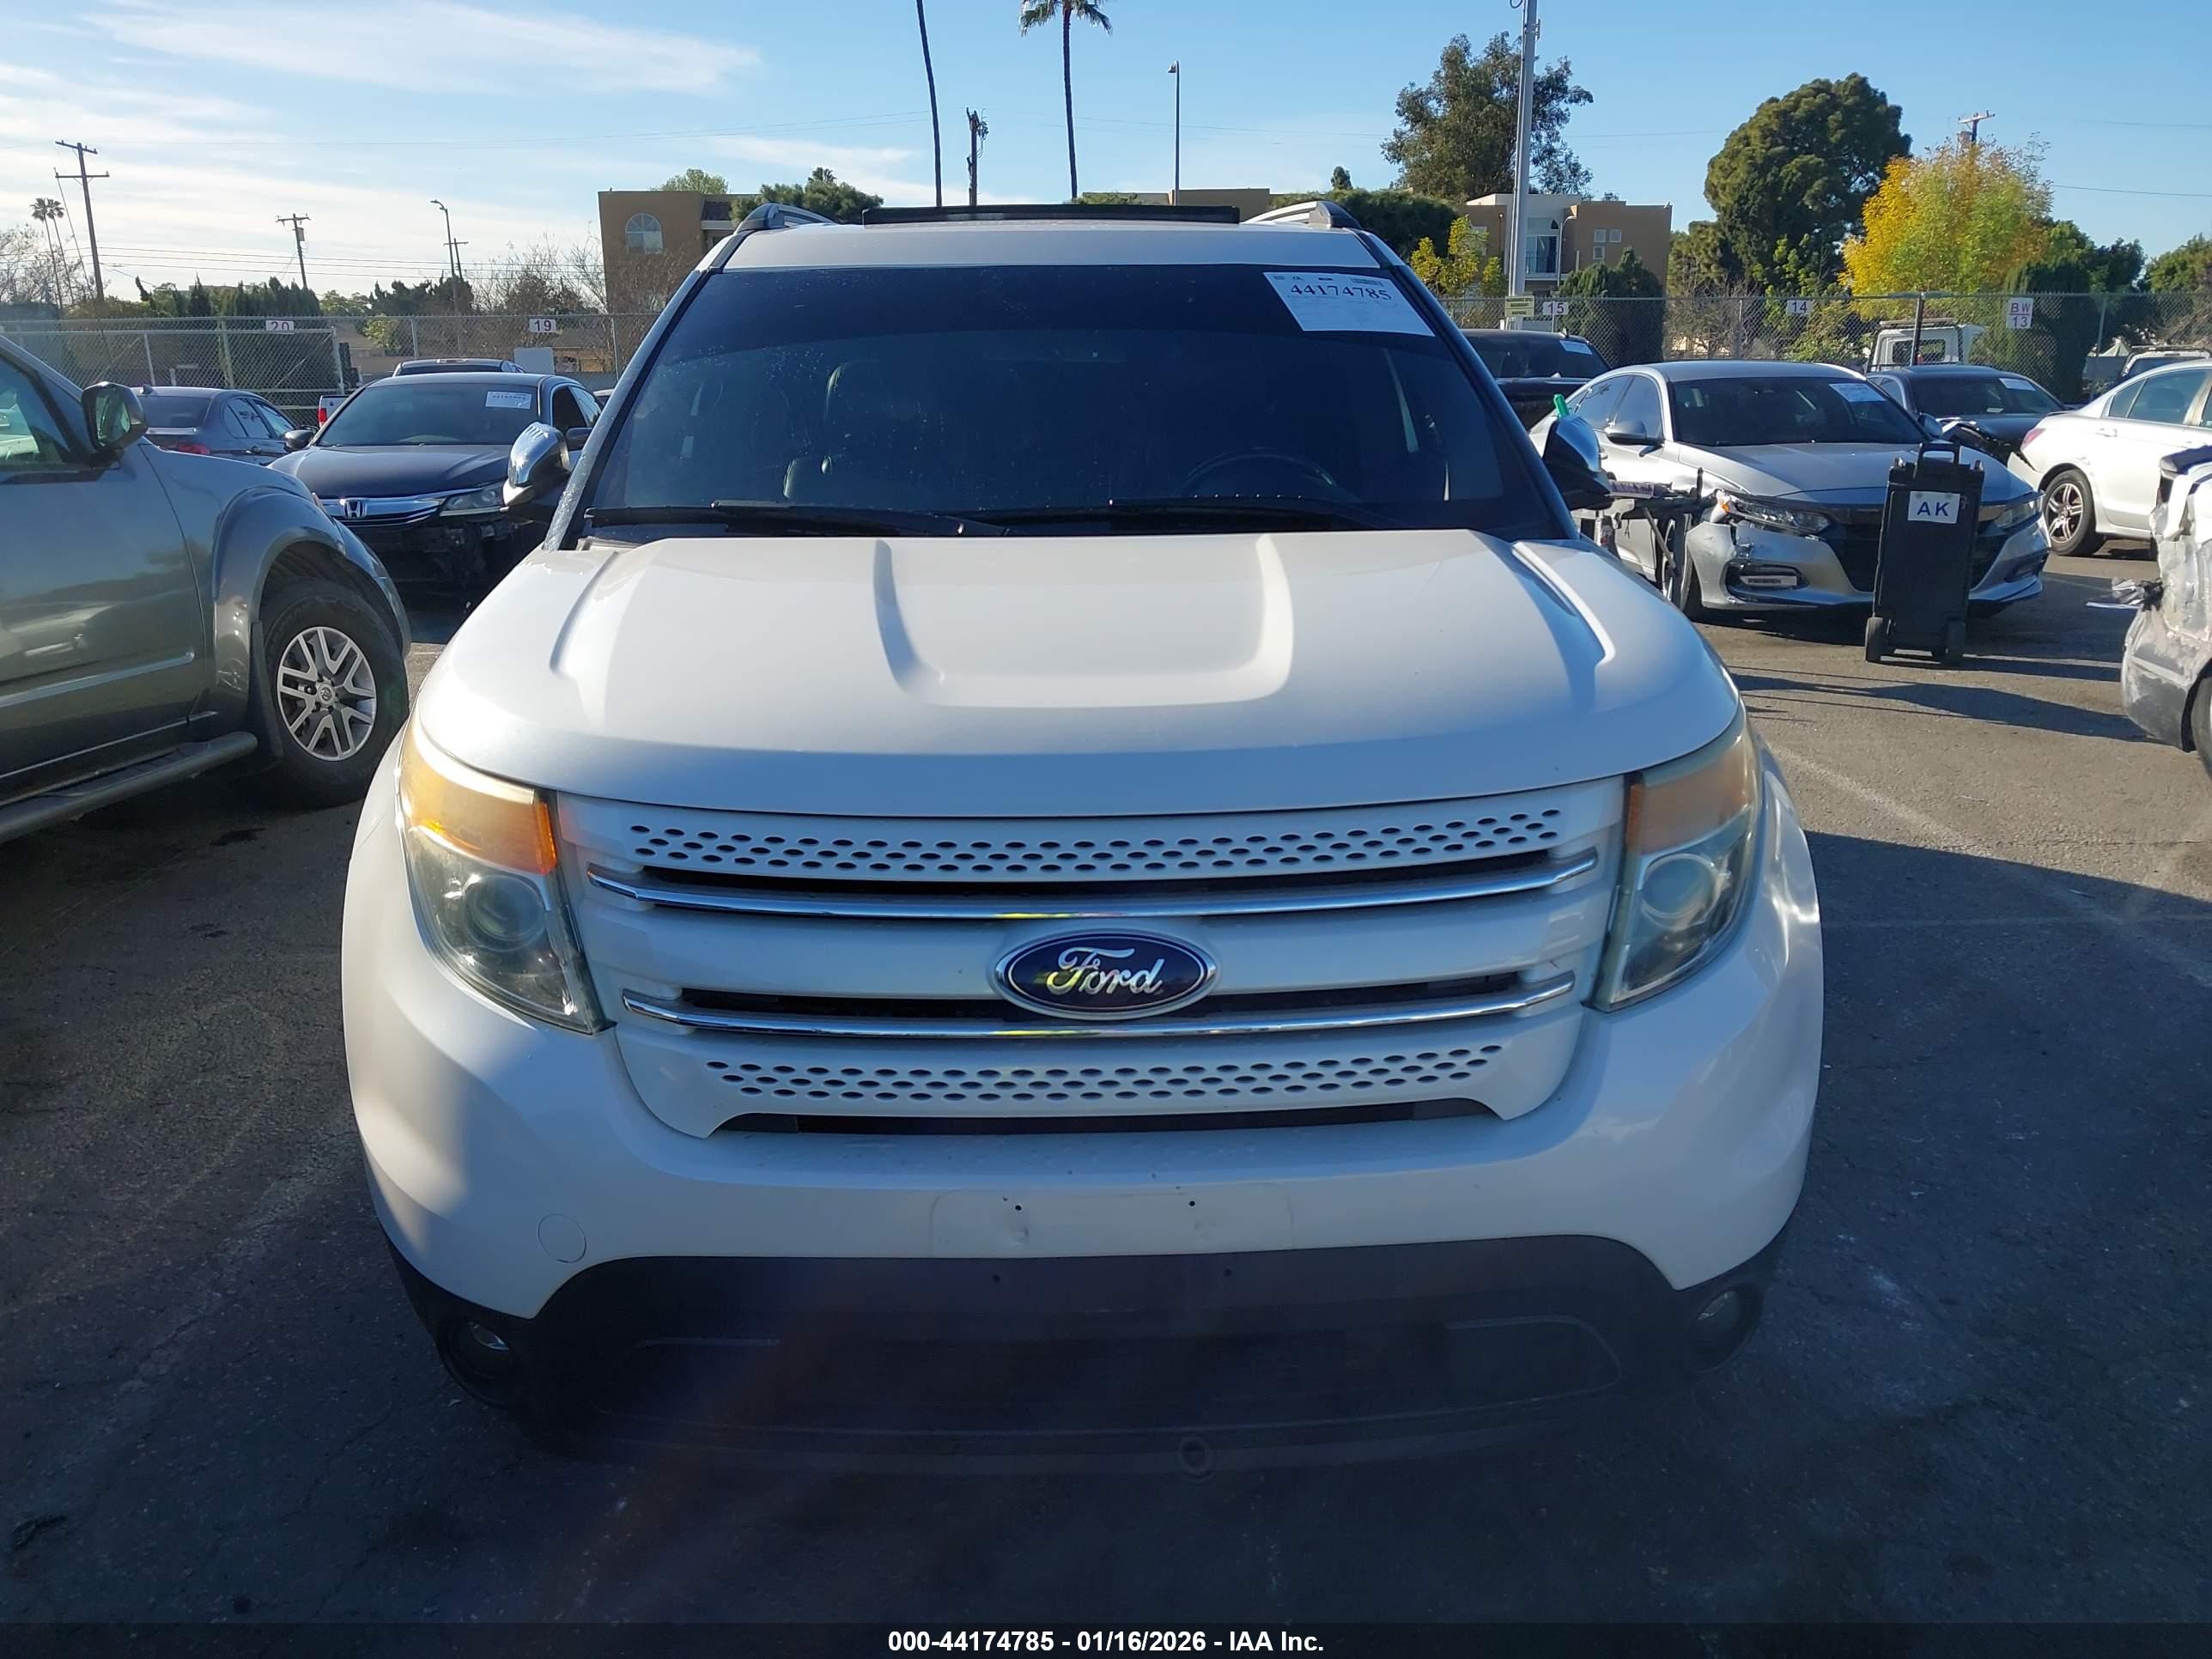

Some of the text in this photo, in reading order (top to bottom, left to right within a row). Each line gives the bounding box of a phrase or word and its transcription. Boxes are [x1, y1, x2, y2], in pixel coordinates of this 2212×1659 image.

[1291, 284, 1392, 301] 44174785
[1547, 302, 1565, 313] 15
[1791, 301, 1808, 313] 14
[534, 320, 552, 331] 19
[2013, 315, 2029, 327] 13
[1917, 501, 1949, 516] AK
[1046, 946, 1164, 994] Ford
